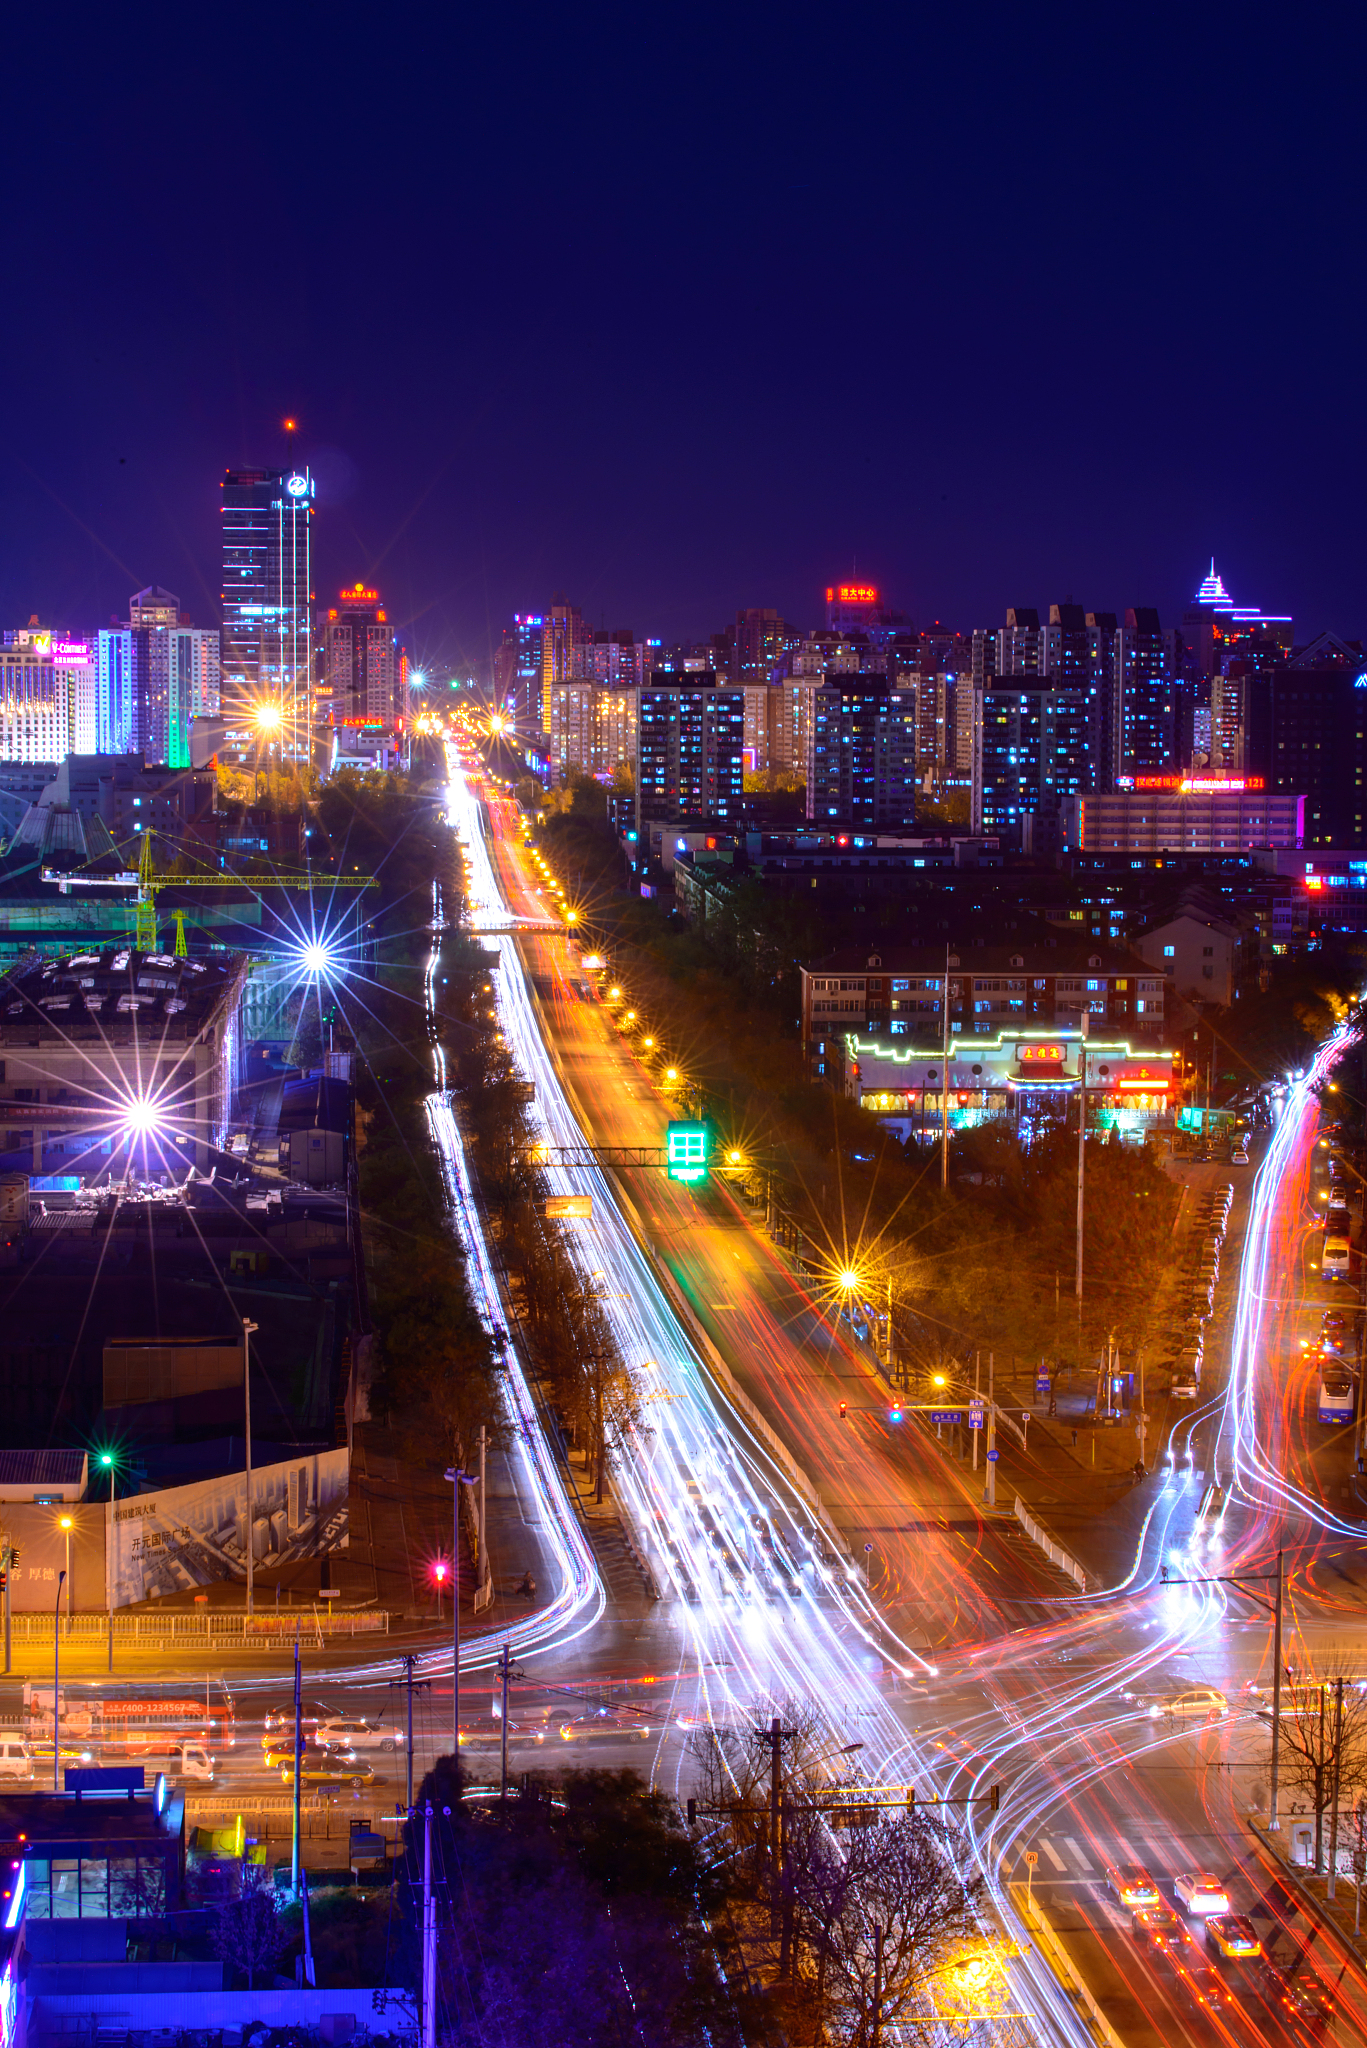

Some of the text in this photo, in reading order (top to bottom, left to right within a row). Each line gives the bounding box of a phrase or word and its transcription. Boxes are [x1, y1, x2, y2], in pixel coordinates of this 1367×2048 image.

[131, 1526, 190, 1551] 开元国际广场
[131, 1553, 145, 1562] New
[147, 1548, 166, 1558] Times
[127, 1703, 185, 1713] 400-1234567
